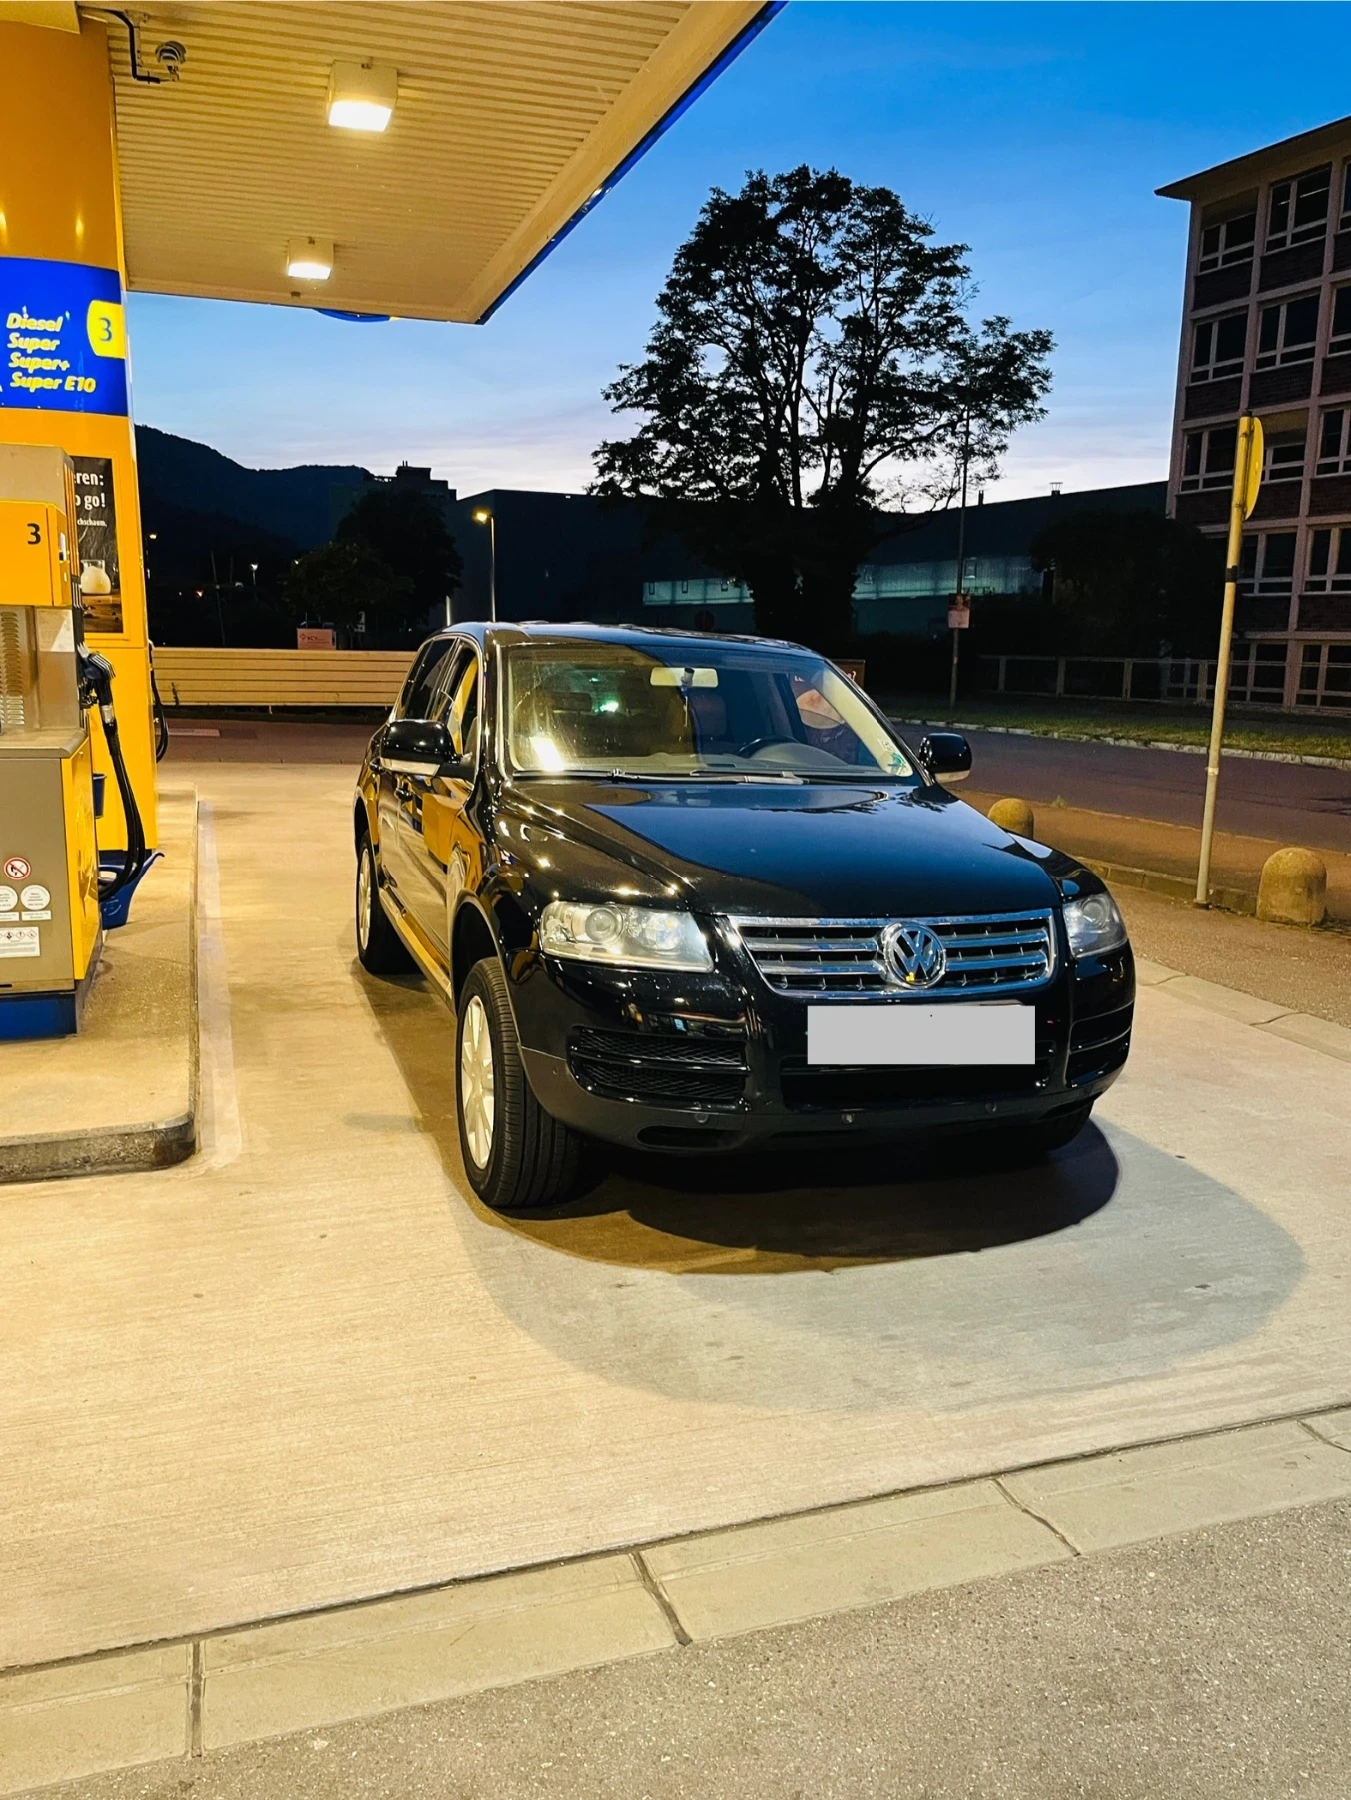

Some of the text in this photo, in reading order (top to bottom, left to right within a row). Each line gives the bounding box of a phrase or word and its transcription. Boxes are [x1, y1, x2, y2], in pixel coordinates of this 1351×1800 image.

[6, 312, 64, 332] Diesel
[99, 317, 113, 342] 3
[7, 332, 61, 354] Super
[8, 352, 70, 373] Super+
[10, 371, 97, 393] Super E10
[73, 471, 105, 487] ren:
[84, 493, 106, 511] go!
[27, 522, 42, 545] 3
[886, 926, 941, 986] VW
